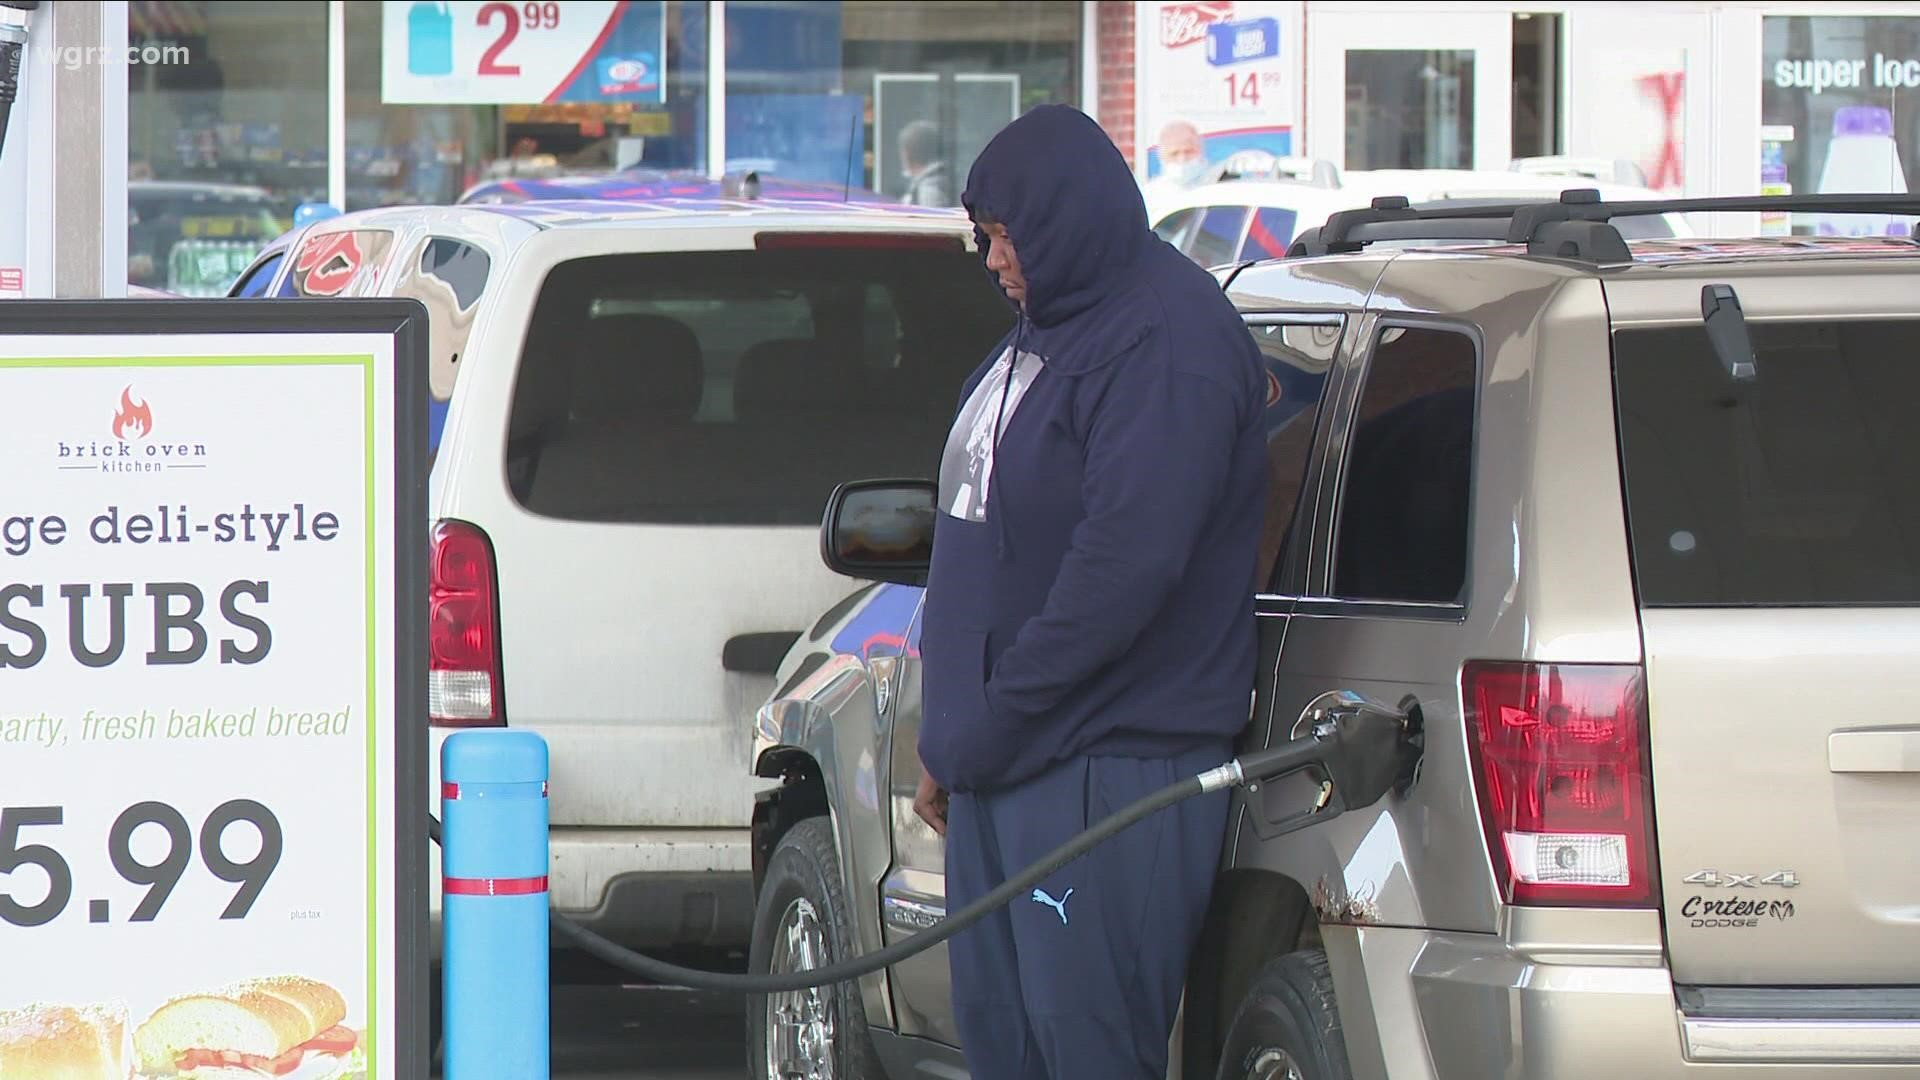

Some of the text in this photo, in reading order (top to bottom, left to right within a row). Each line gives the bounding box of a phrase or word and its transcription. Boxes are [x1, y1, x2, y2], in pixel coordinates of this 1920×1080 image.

[1775, 59, 1866, 95] super
[58, 441, 207, 457] brick oven
[102, 461, 162, 473] kitchen
[2, 503, 340, 556] ge deli-style
[0, 579, 273, 670] SUBS
[0, 704, 352, 748] arty, fresh baked bread
[0, 798, 284, 927] 5.99
[1682, 869, 1801, 888] 4x4
[1691, 918, 1759, 928] DODGE
